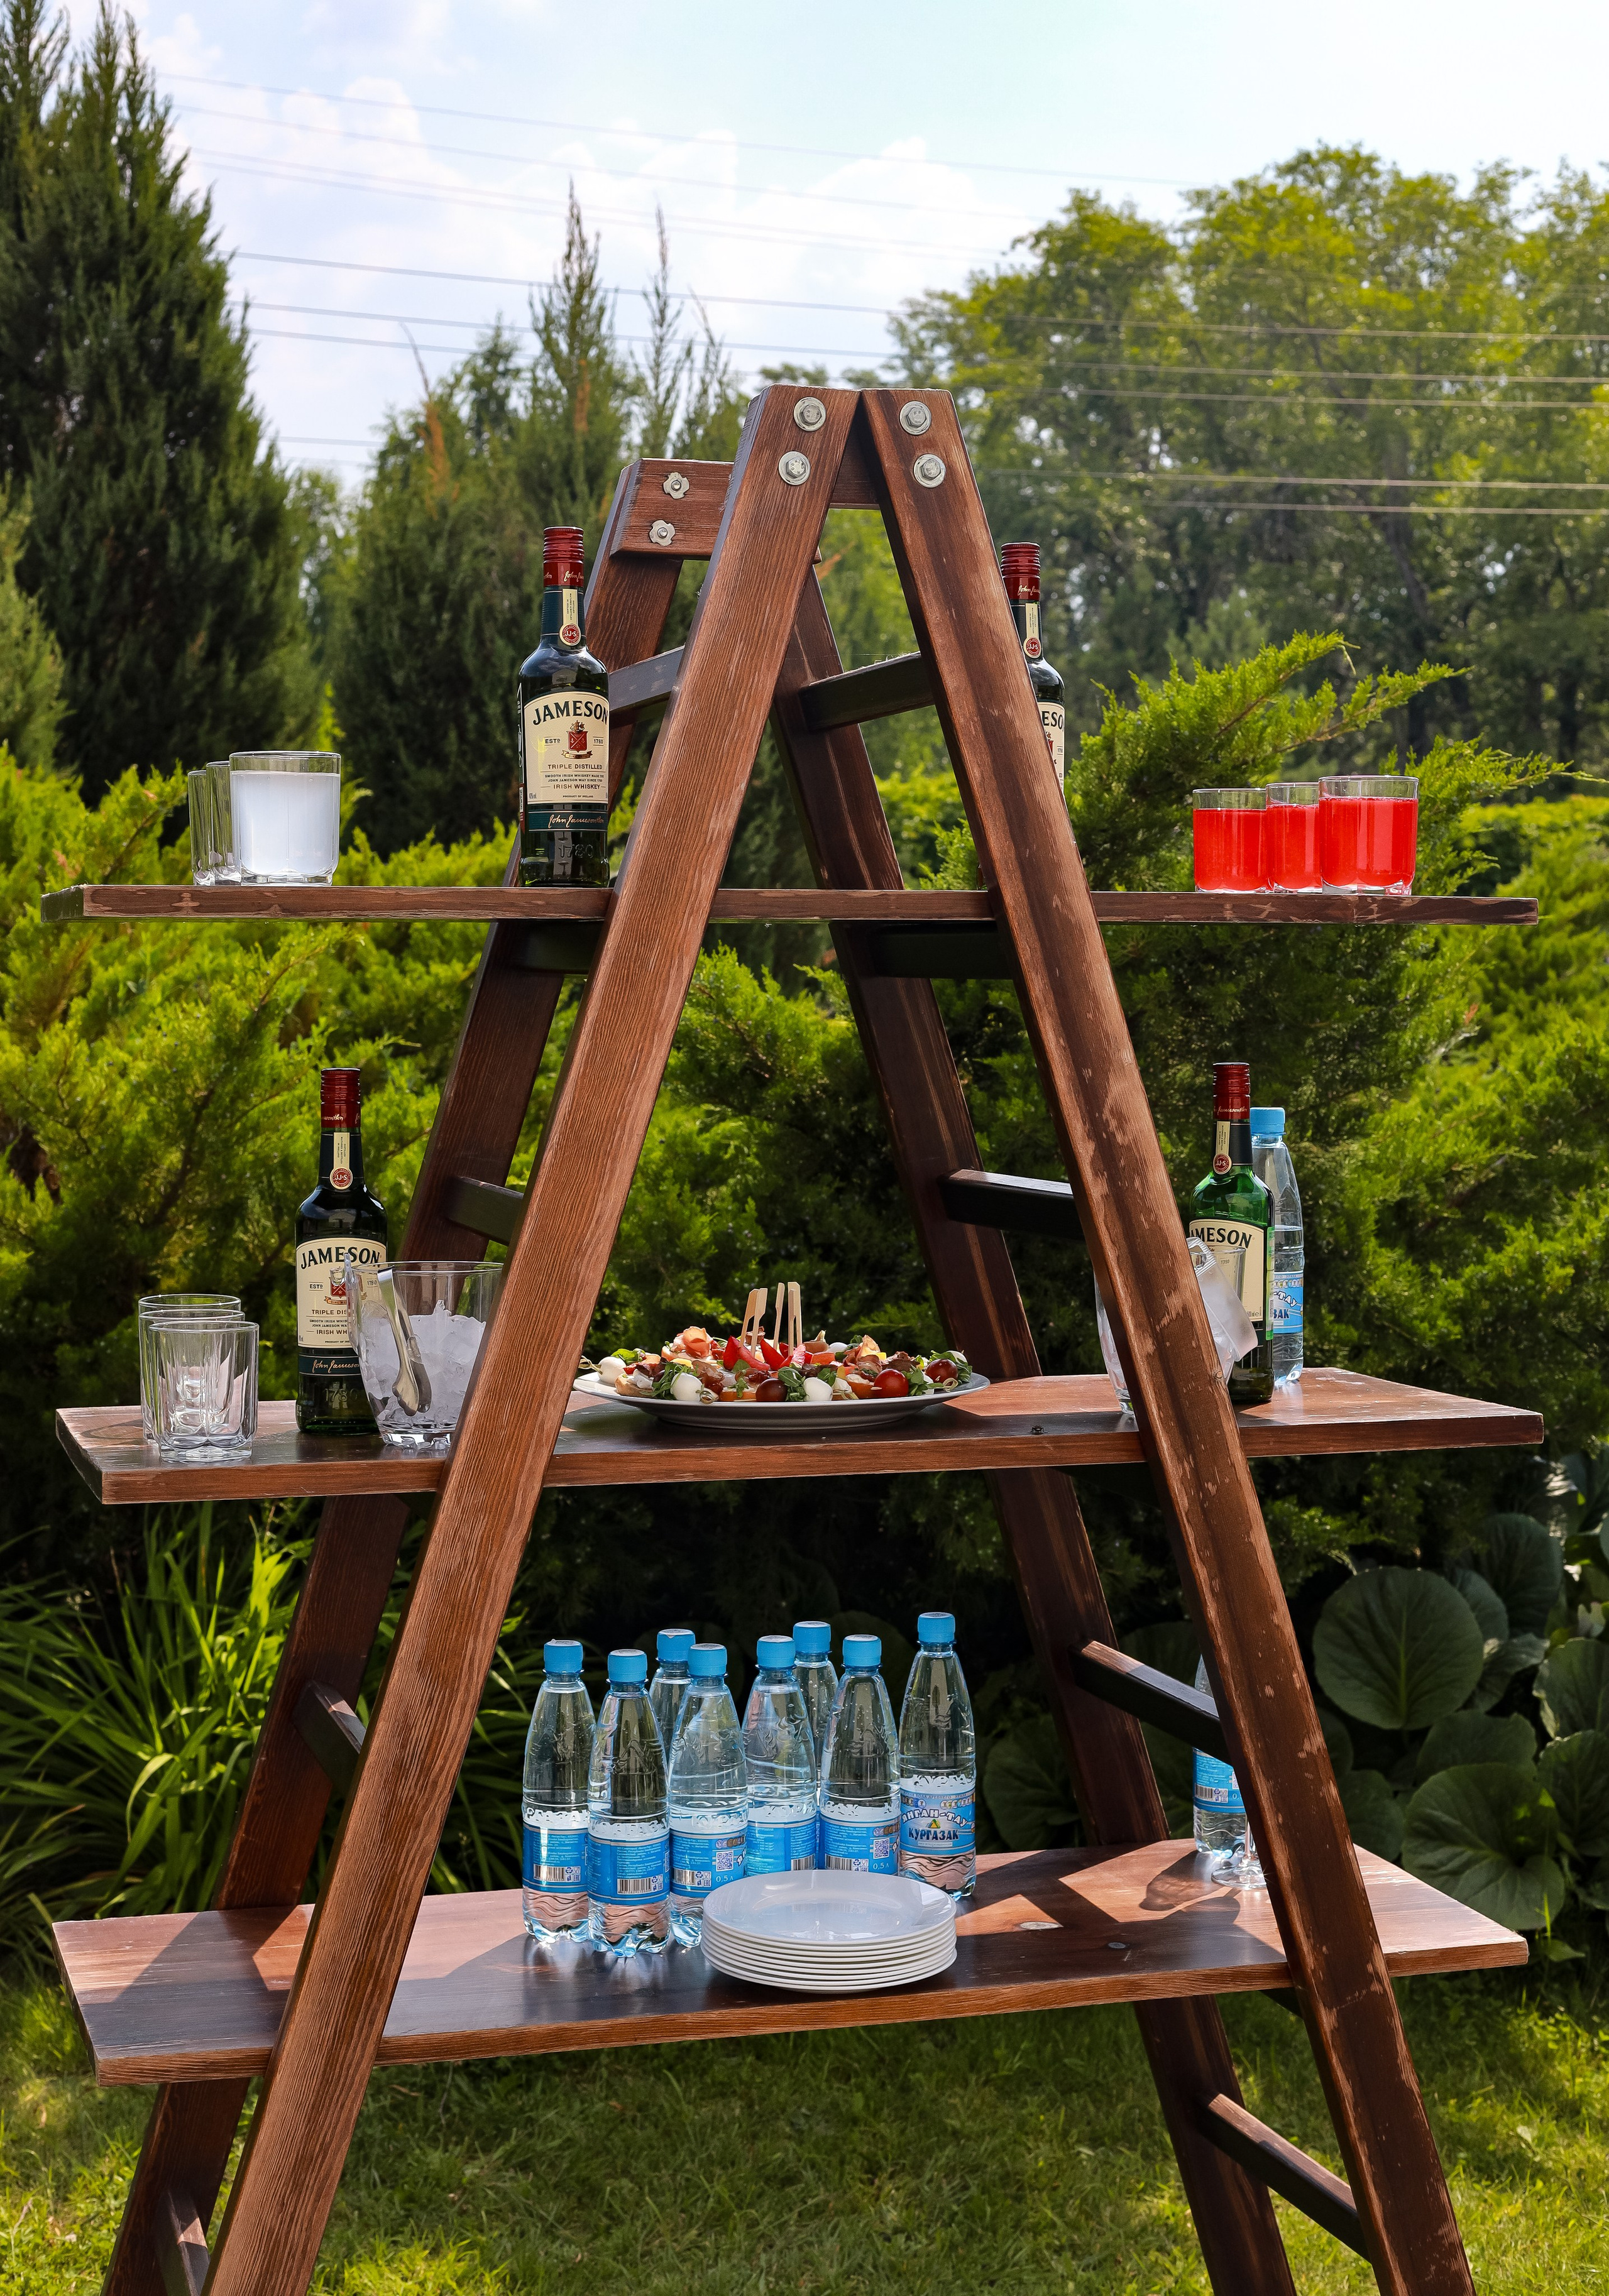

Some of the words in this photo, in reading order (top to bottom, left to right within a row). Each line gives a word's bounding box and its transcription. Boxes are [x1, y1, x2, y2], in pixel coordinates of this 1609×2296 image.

[533, 700, 608, 725] JAMESON
[548, 814, 566, 828] John
[558, 844, 593, 858] 1780
[300, 1247, 381, 1270] JAMESON
[312, 1359, 328, 1373] John
[323, 1388, 358, 1403] 1780
[901, 1808, 968, 1827] ЯНГАН-ТАУ
[908, 1827, 959, 1841] КУРГАЗАК
